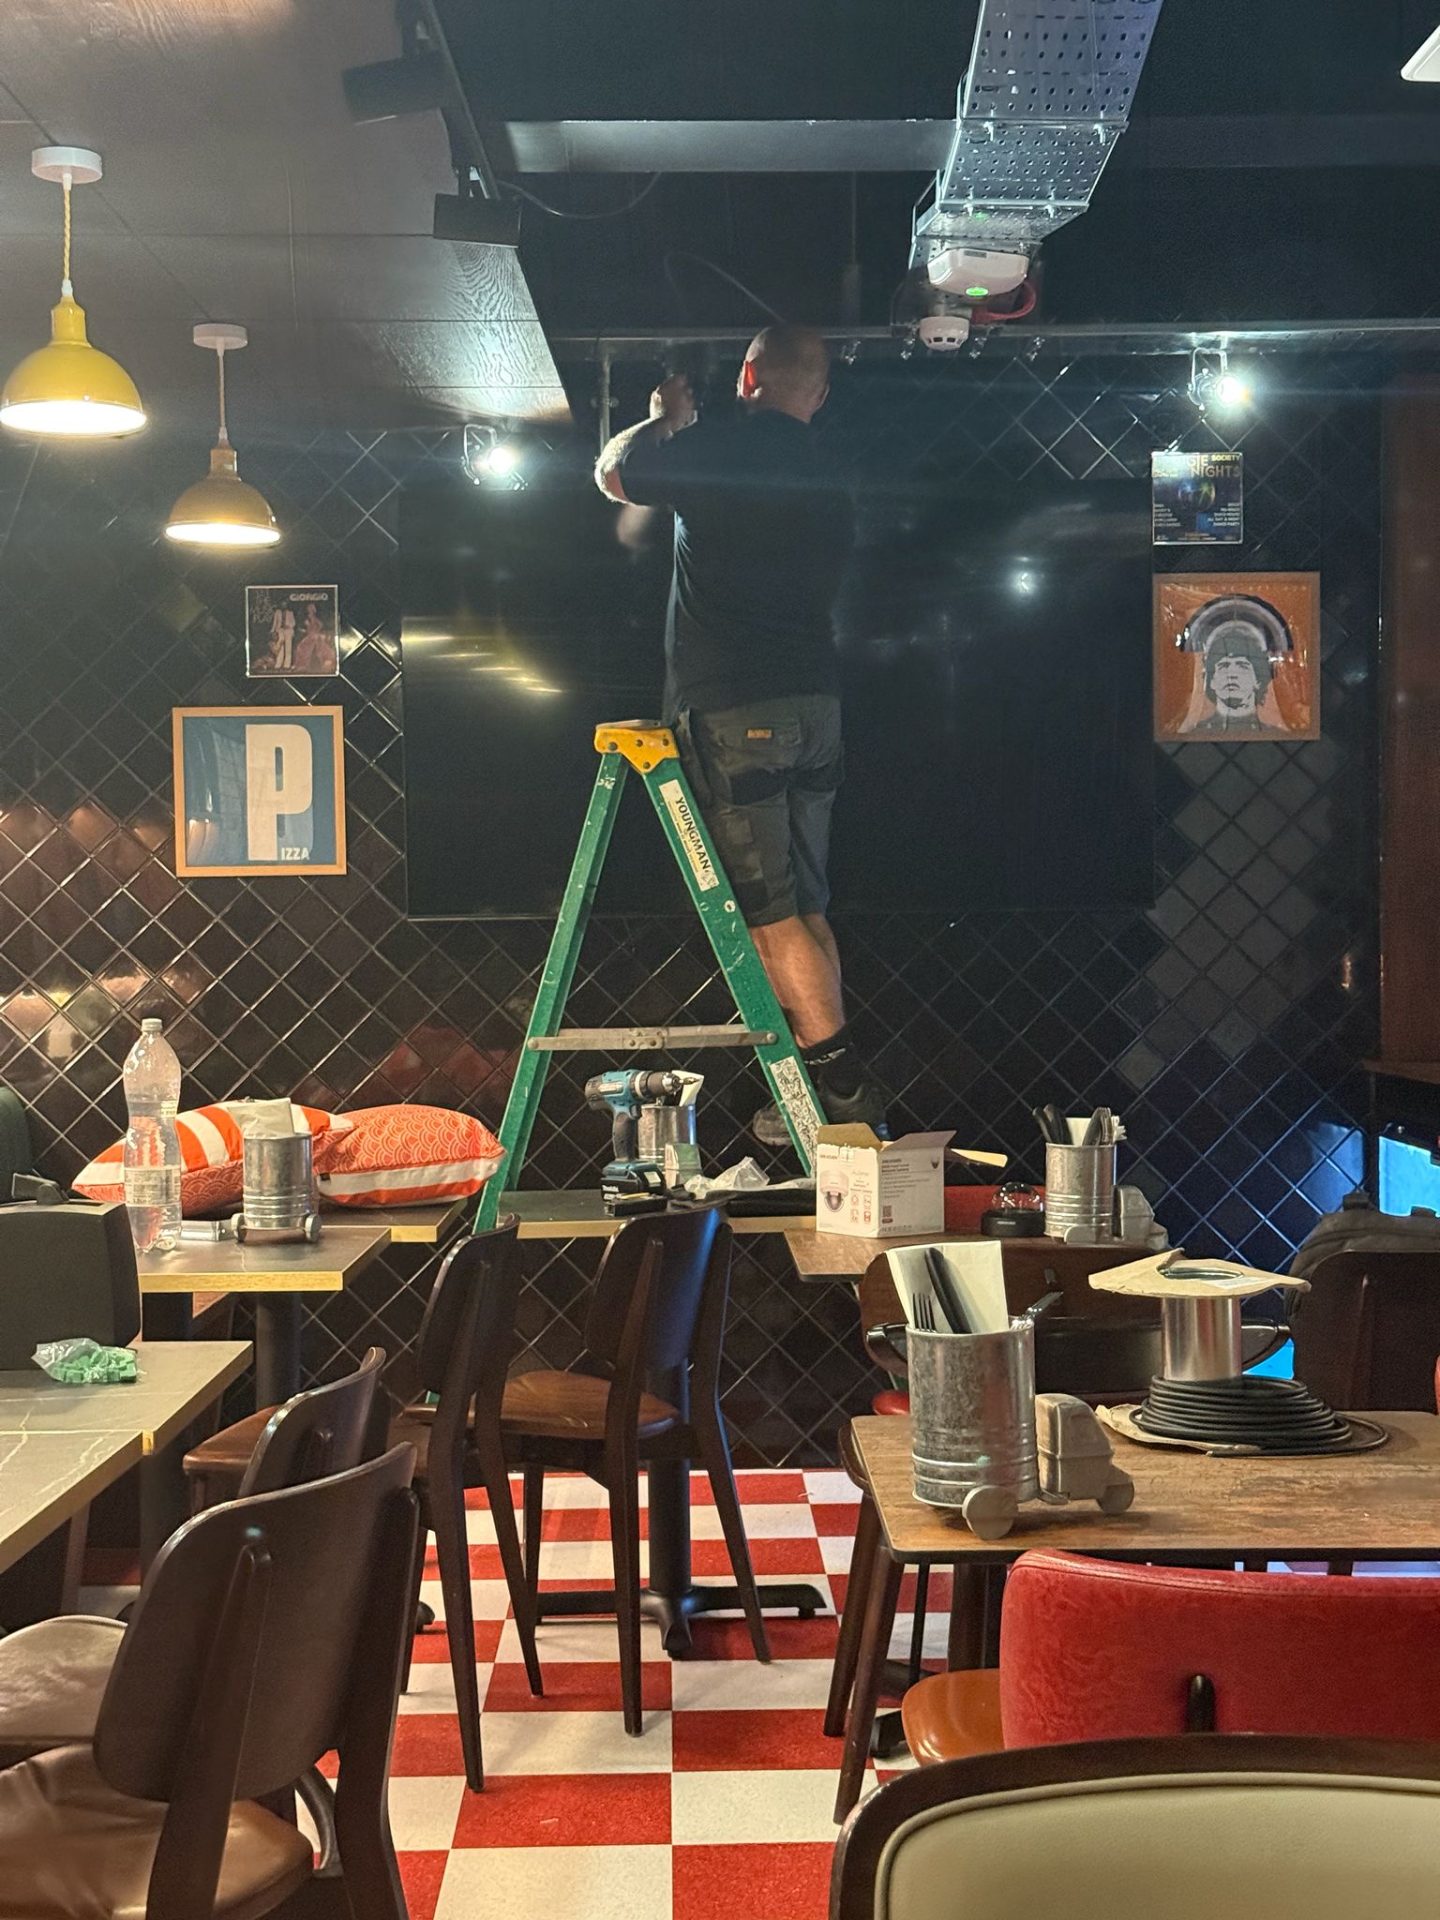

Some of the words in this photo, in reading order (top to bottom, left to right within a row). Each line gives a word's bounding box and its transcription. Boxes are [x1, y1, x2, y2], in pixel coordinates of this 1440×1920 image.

[1211, 454, 1240, 462] SOCIETY
[1190, 465, 1240, 478] NIGHTS
[289, 593, 328, 601] GIORGIO
[675, 796, 712, 870] YOUNGMAN
